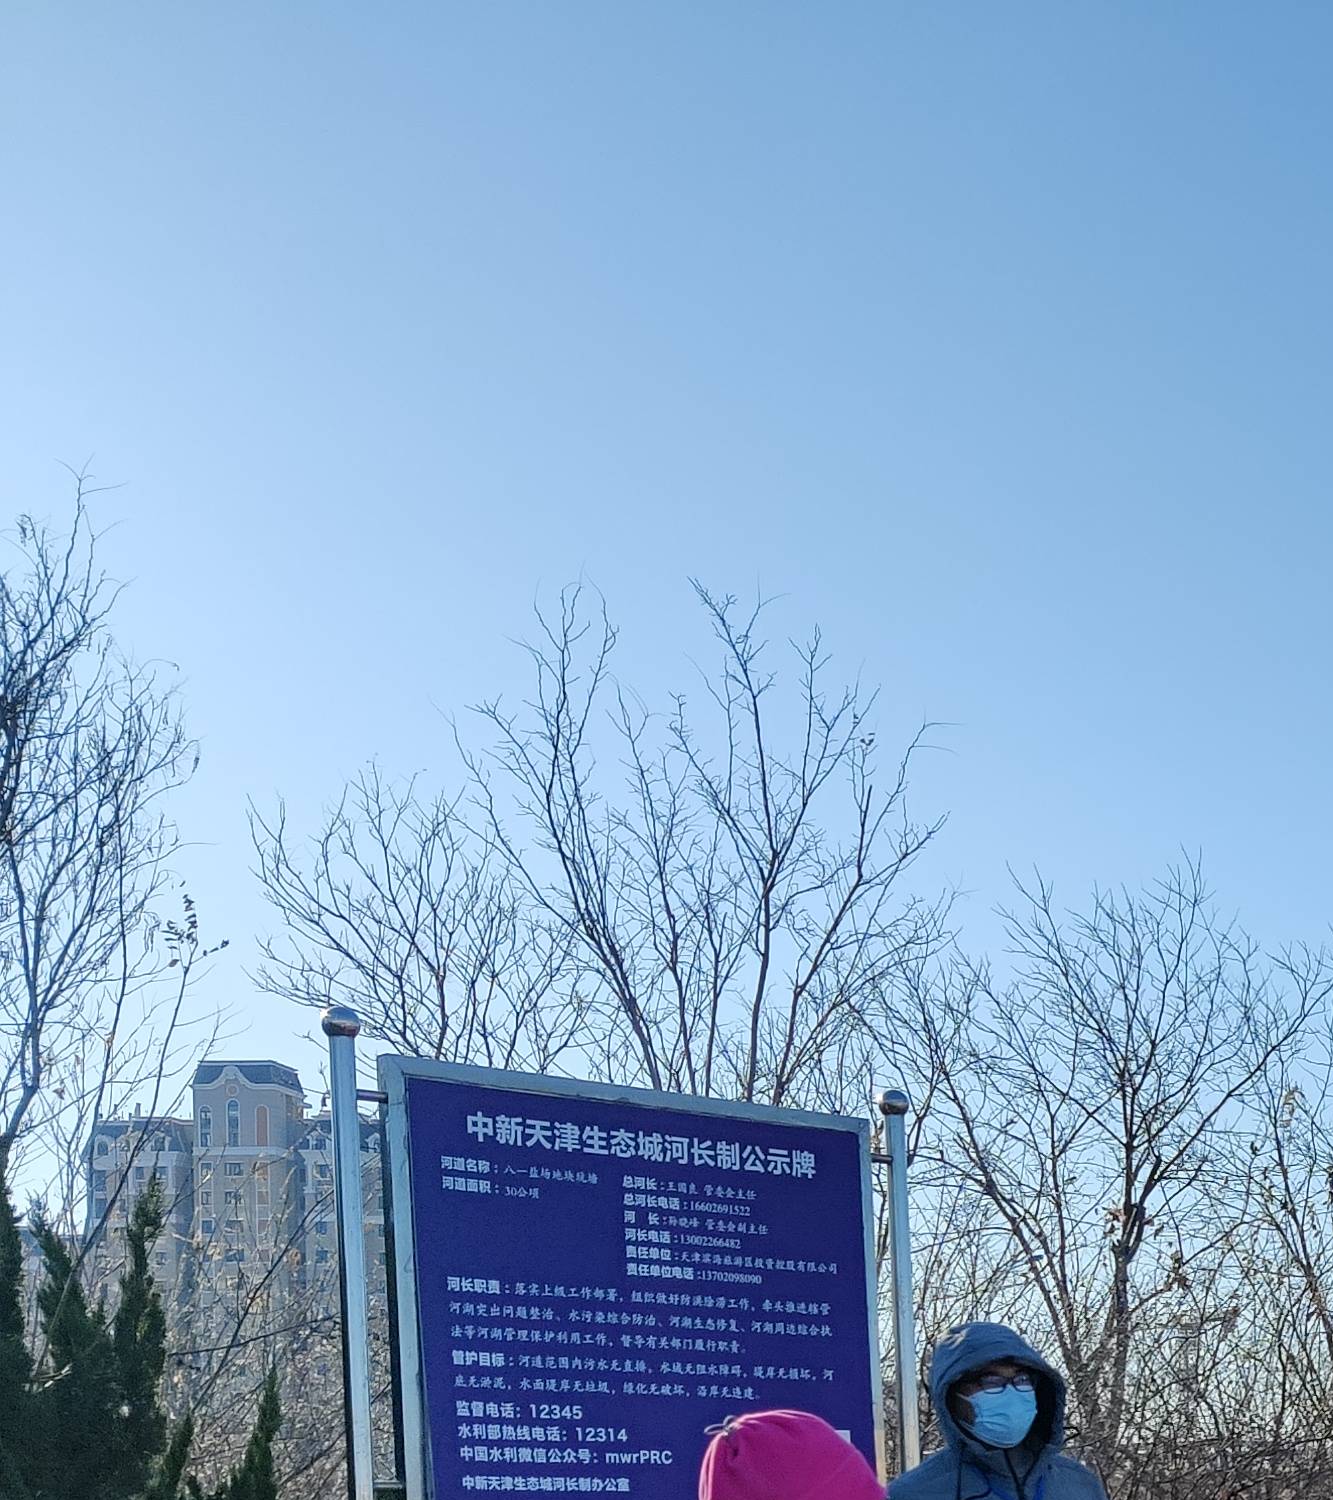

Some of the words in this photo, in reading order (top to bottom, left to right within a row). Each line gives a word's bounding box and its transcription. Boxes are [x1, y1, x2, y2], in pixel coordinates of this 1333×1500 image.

[466, 1111, 817, 1179] 中新天津生态城河长制公示牌
[456, 1400, 583, 1420] 监督电话：12345
[457, 1422, 628, 1443] 水利部热线电话：12314
[461, 1474, 631, 1493] 中新天津生态城河长制办公室
